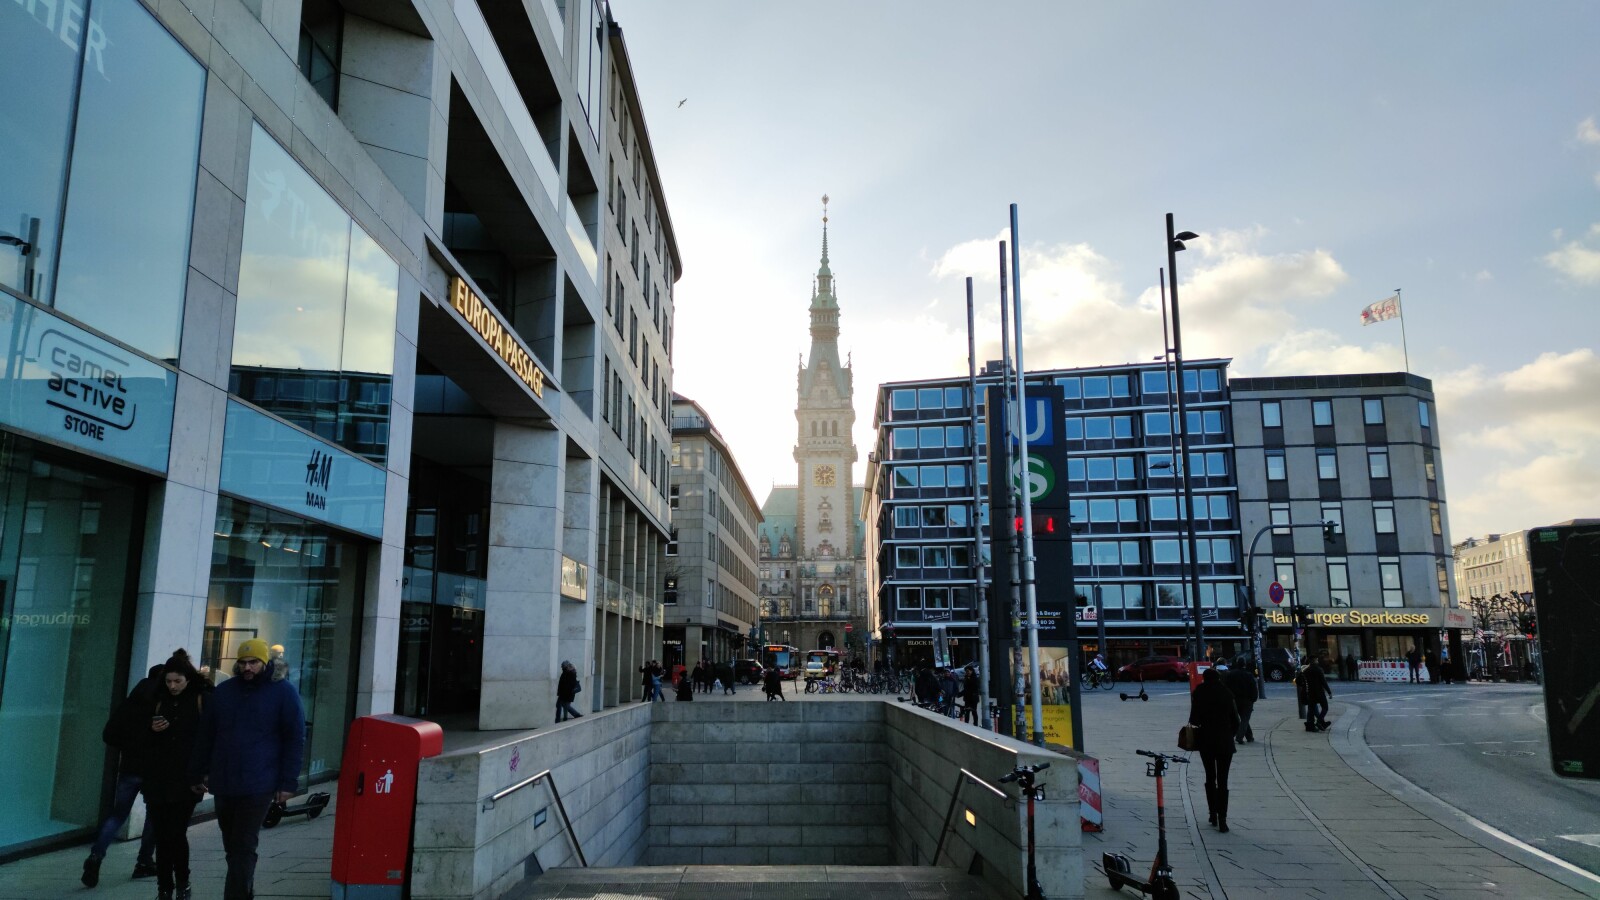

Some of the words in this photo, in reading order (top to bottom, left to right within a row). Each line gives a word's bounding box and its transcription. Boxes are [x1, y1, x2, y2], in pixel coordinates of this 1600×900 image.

[13, 0, 106, 75] HER
[456, 277, 503, 357] EUROPA
[505, 333, 544, 399] PASSAGE
[51, 346, 127, 393] camel
[64, 415, 104, 441] STORE
[1010, 399, 1046, 442] U
[305, 448, 333, 492] H&M
[1012, 456, 1048, 499] S
[305, 491, 326, 510] MAN
[1264, 610, 1347, 626] Haurger
[1349, 610, 1429, 626] Sparkasse
